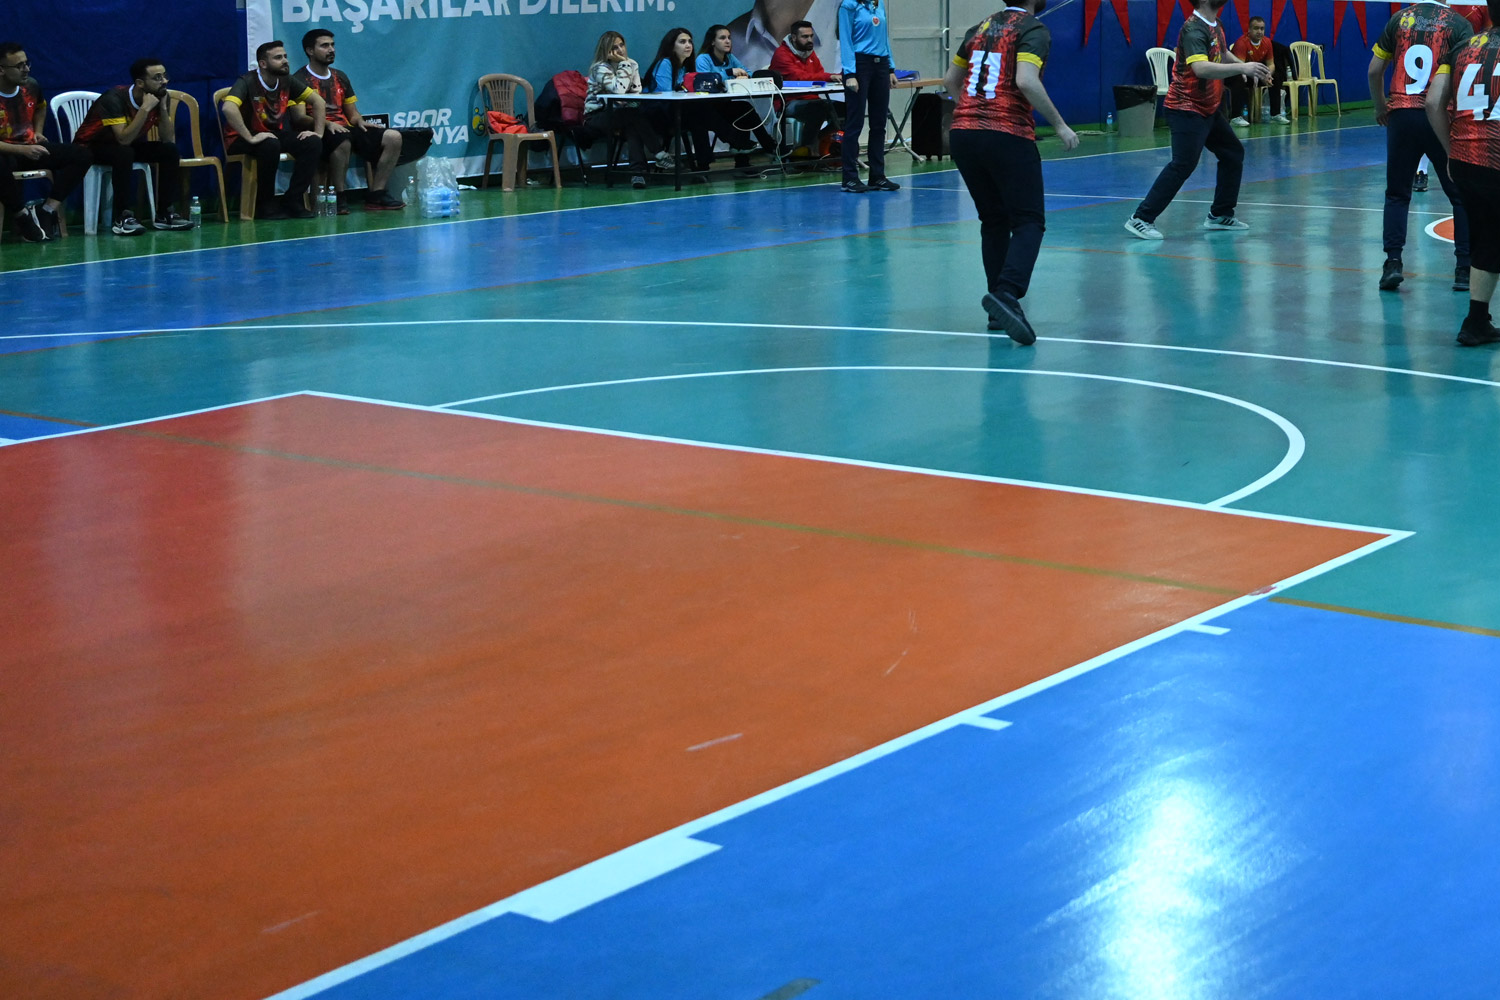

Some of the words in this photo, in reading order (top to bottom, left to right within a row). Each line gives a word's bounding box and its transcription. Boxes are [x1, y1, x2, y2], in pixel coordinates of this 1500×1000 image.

[967, 50, 1002, 99] 11
[1404, 44, 1433, 95] 9
[393, 108, 451, 127] SPOR
